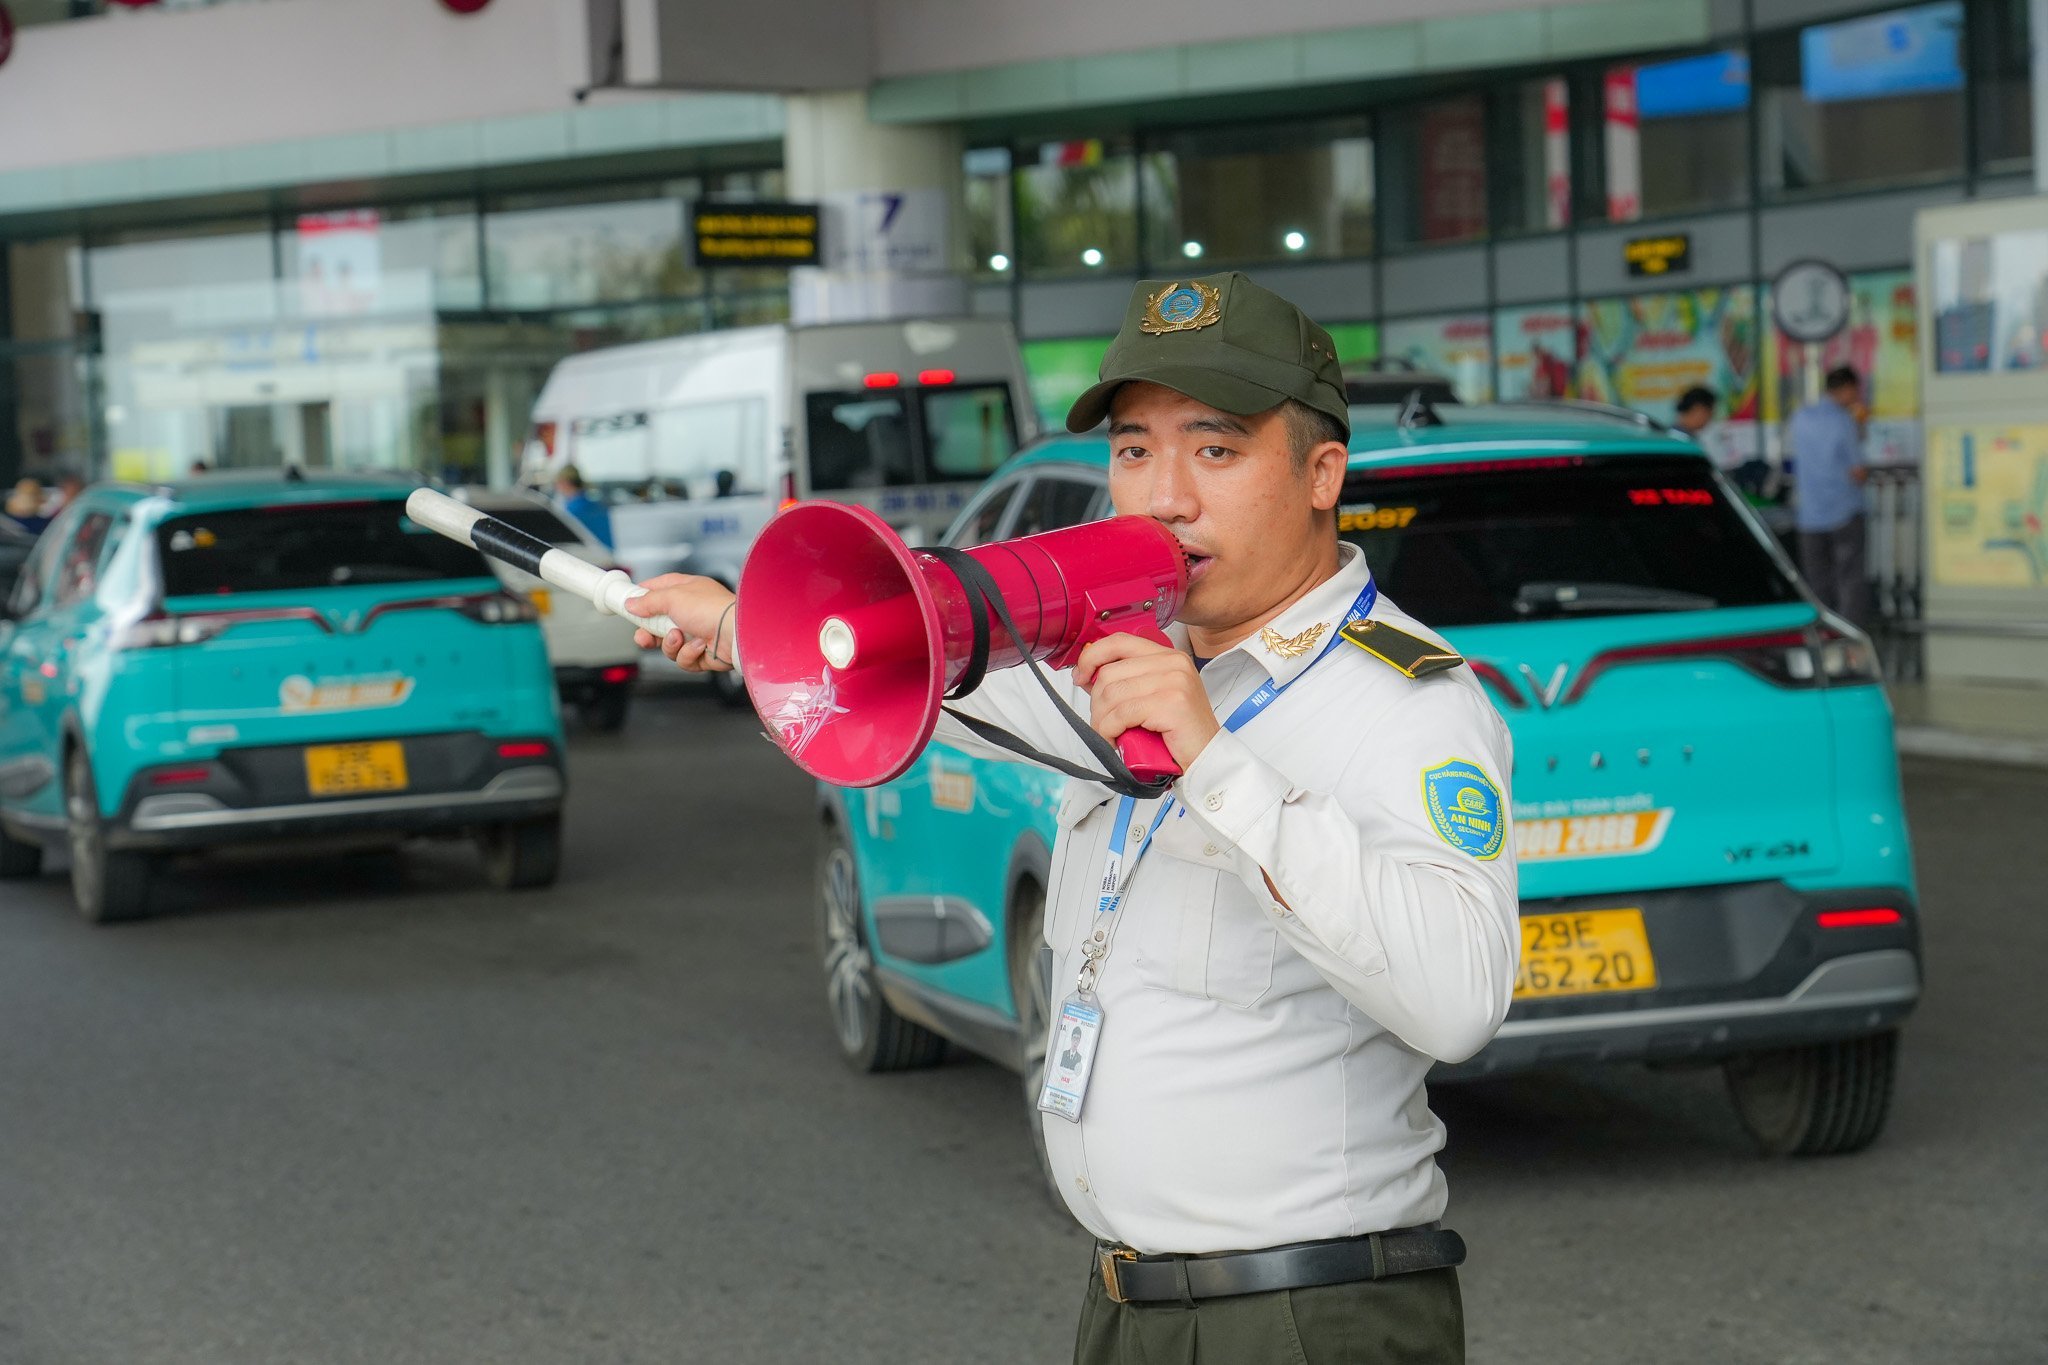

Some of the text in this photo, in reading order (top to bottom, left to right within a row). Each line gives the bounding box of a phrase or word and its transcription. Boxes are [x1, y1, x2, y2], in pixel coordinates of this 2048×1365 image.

[1251, 689, 1270, 707] NIA
[1451, 813, 1491, 832] AN NINH
[1099, 896, 1111, 912] NIA
[1108, 896, 1121, 912] NIA
[1525, 915, 1598, 951] 29E
